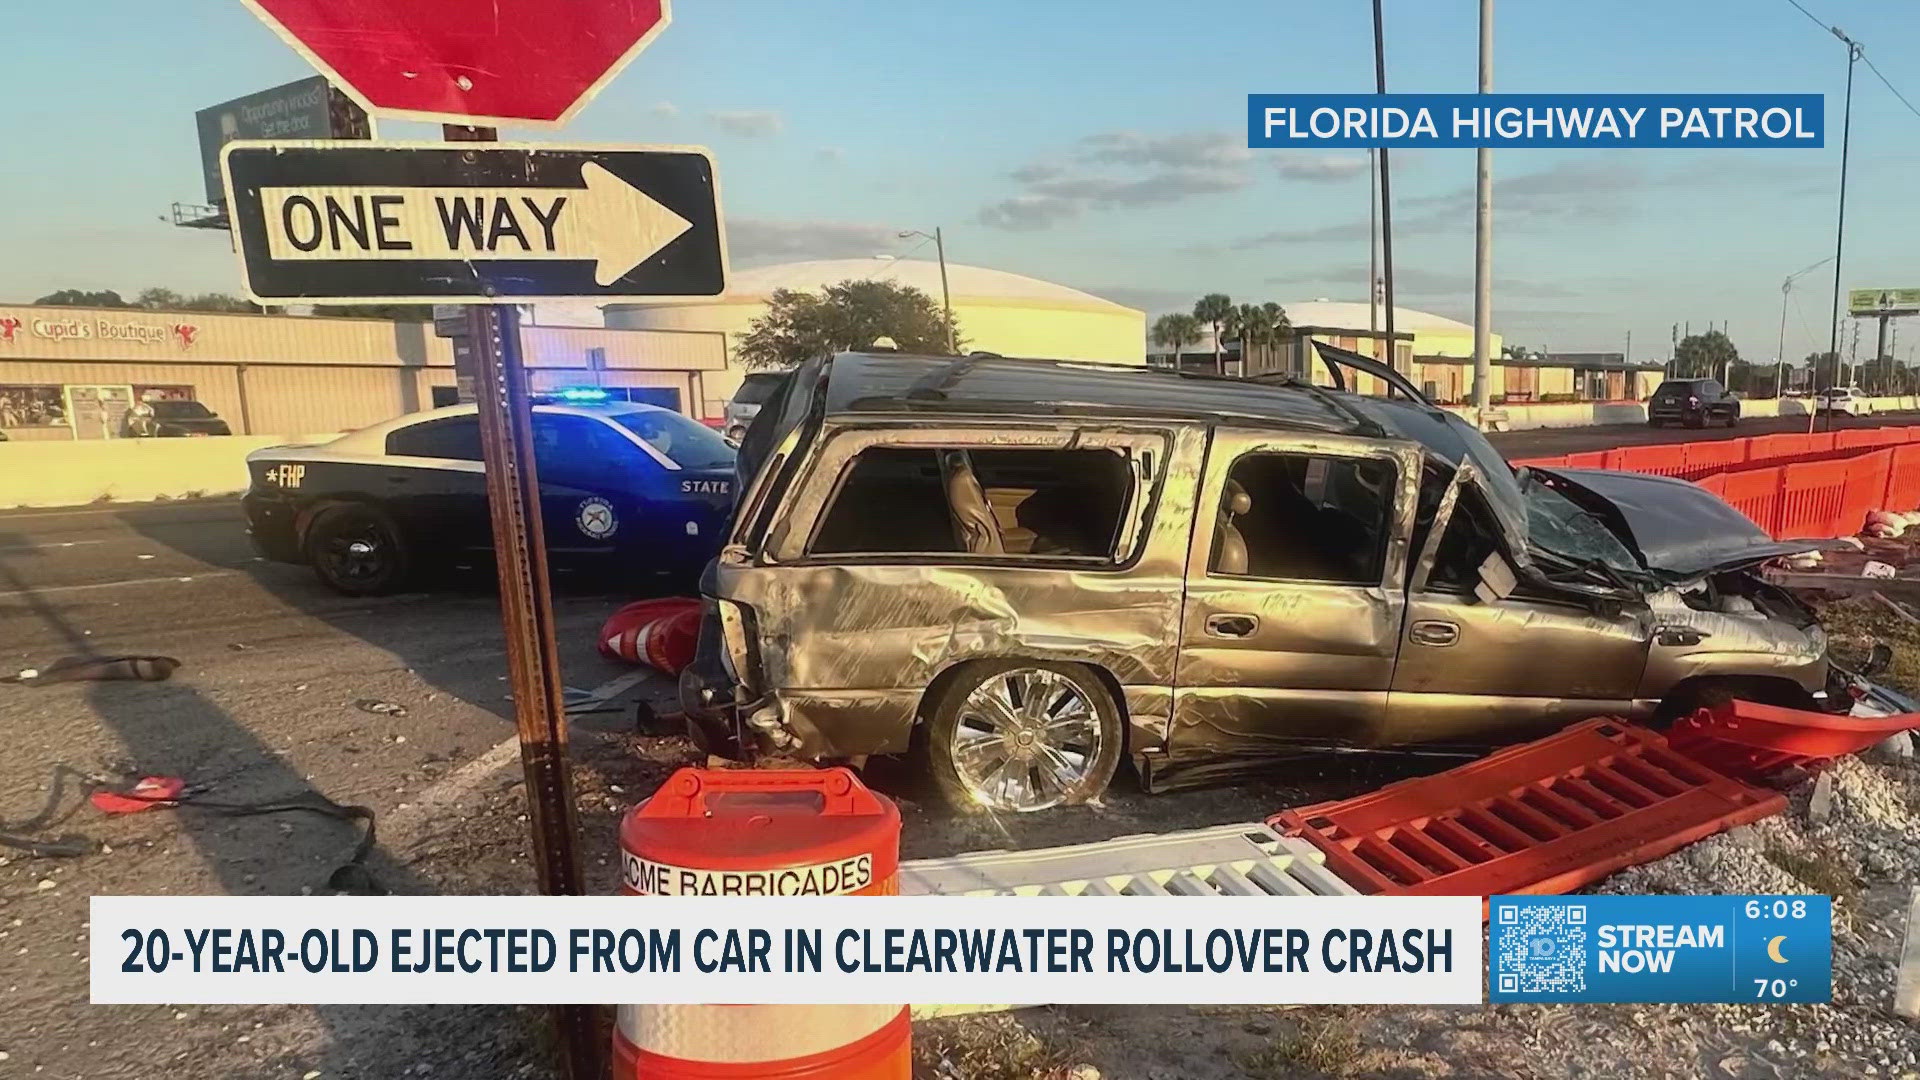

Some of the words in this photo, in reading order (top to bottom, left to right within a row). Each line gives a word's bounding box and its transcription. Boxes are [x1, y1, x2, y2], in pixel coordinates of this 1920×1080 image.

[282, 195, 412, 252] ONE
[434, 196, 567, 252] WAY
[33, 319, 90, 338] Cupid's
[99, 321, 165, 343] Boutique
[279, 464, 306, 489] FHP
[681, 480, 730, 494] STATE
[680, 855, 870, 896] BARRICADES
